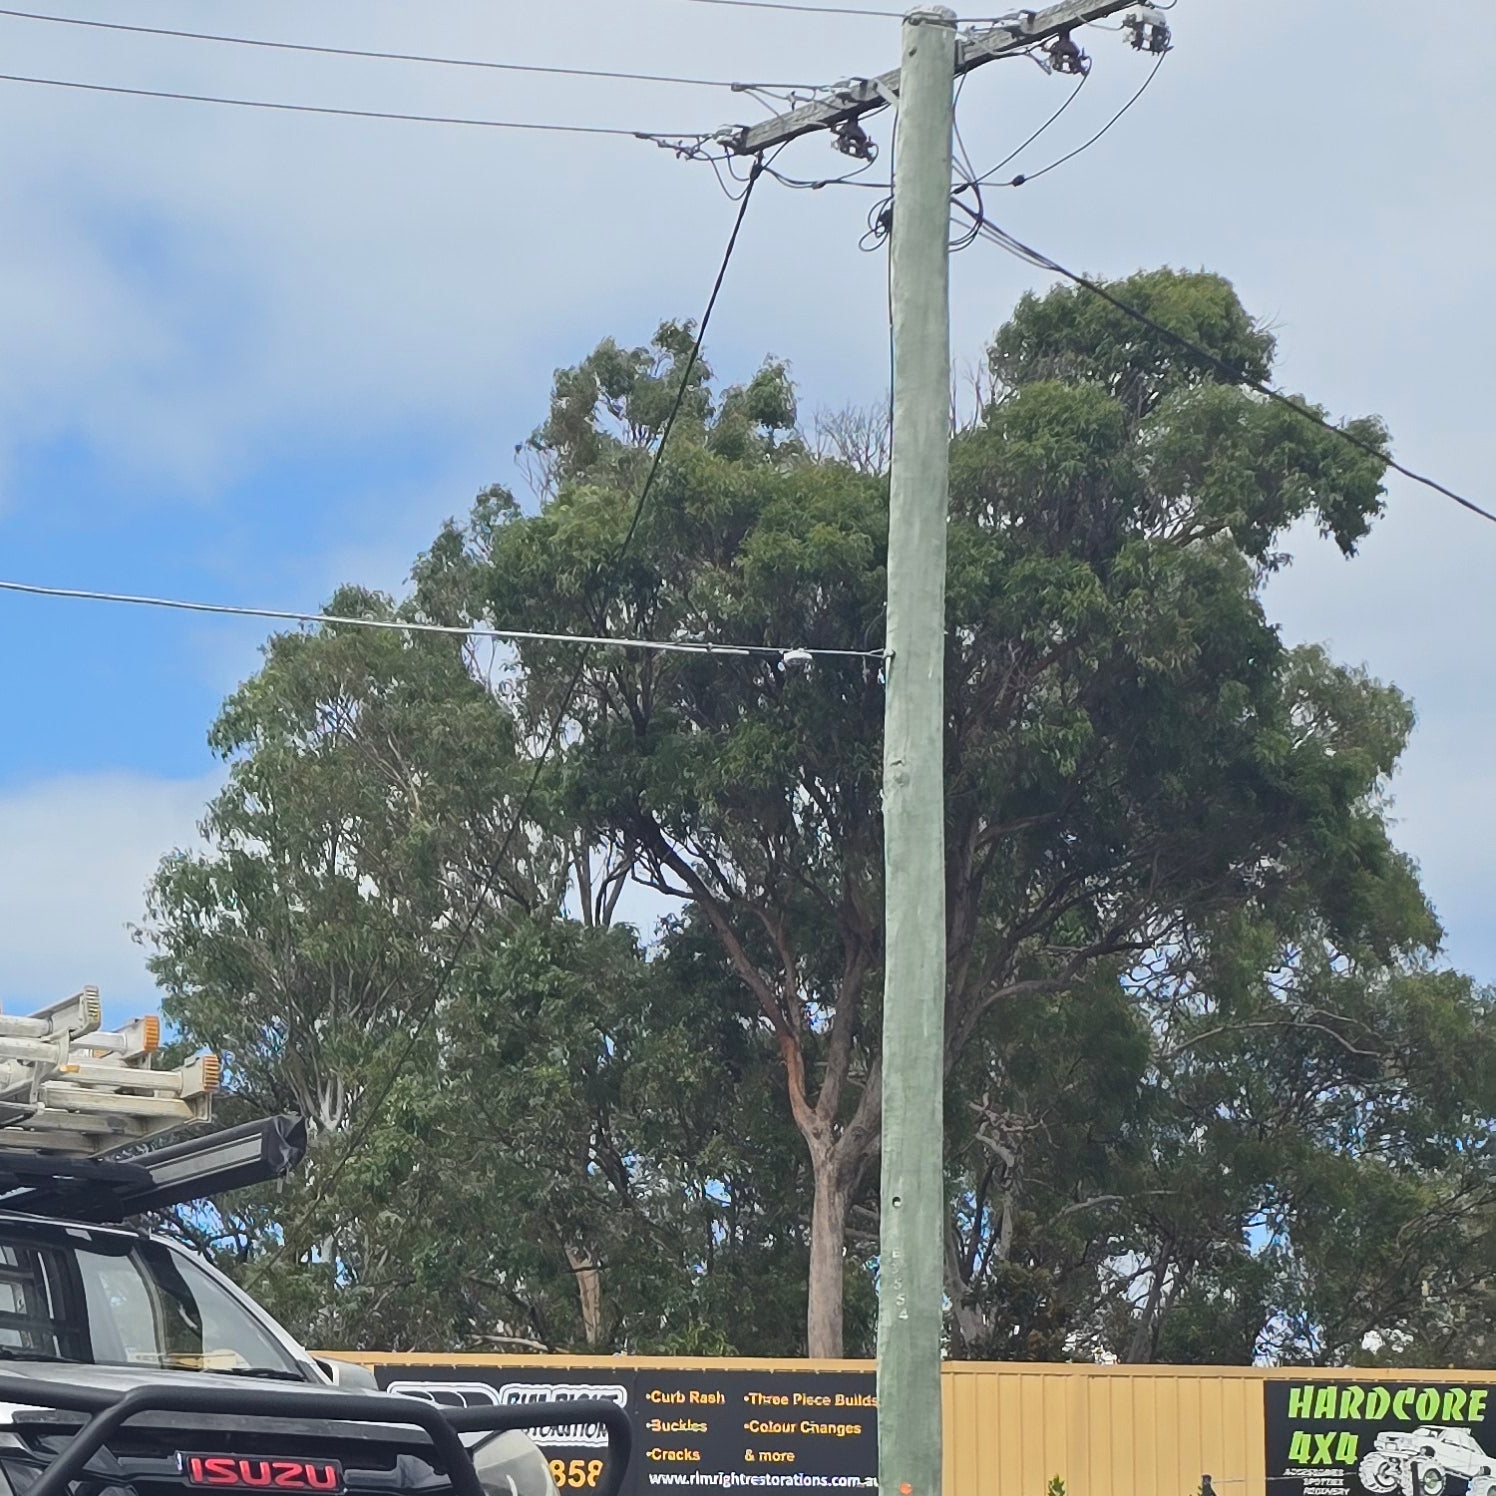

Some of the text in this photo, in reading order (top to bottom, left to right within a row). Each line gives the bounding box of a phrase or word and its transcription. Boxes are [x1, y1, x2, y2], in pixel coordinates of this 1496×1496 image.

[650, 1390, 725, 1404] Curb Rash
[748, 1392, 879, 1407] Three Piece Builds
[1288, 1385, 1489, 1422] HARDCORE
[650, 1419, 707, 1432] Buckles
[749, 1420, 862, 1437] Colour Changes
[651, 1448, 701, 1461] Cracks
[1288, 1430, 1359, 1465] 4X4
[744, 1449, 795, 1462] & more
[190, 1458, 337, 1489] ISUZU
